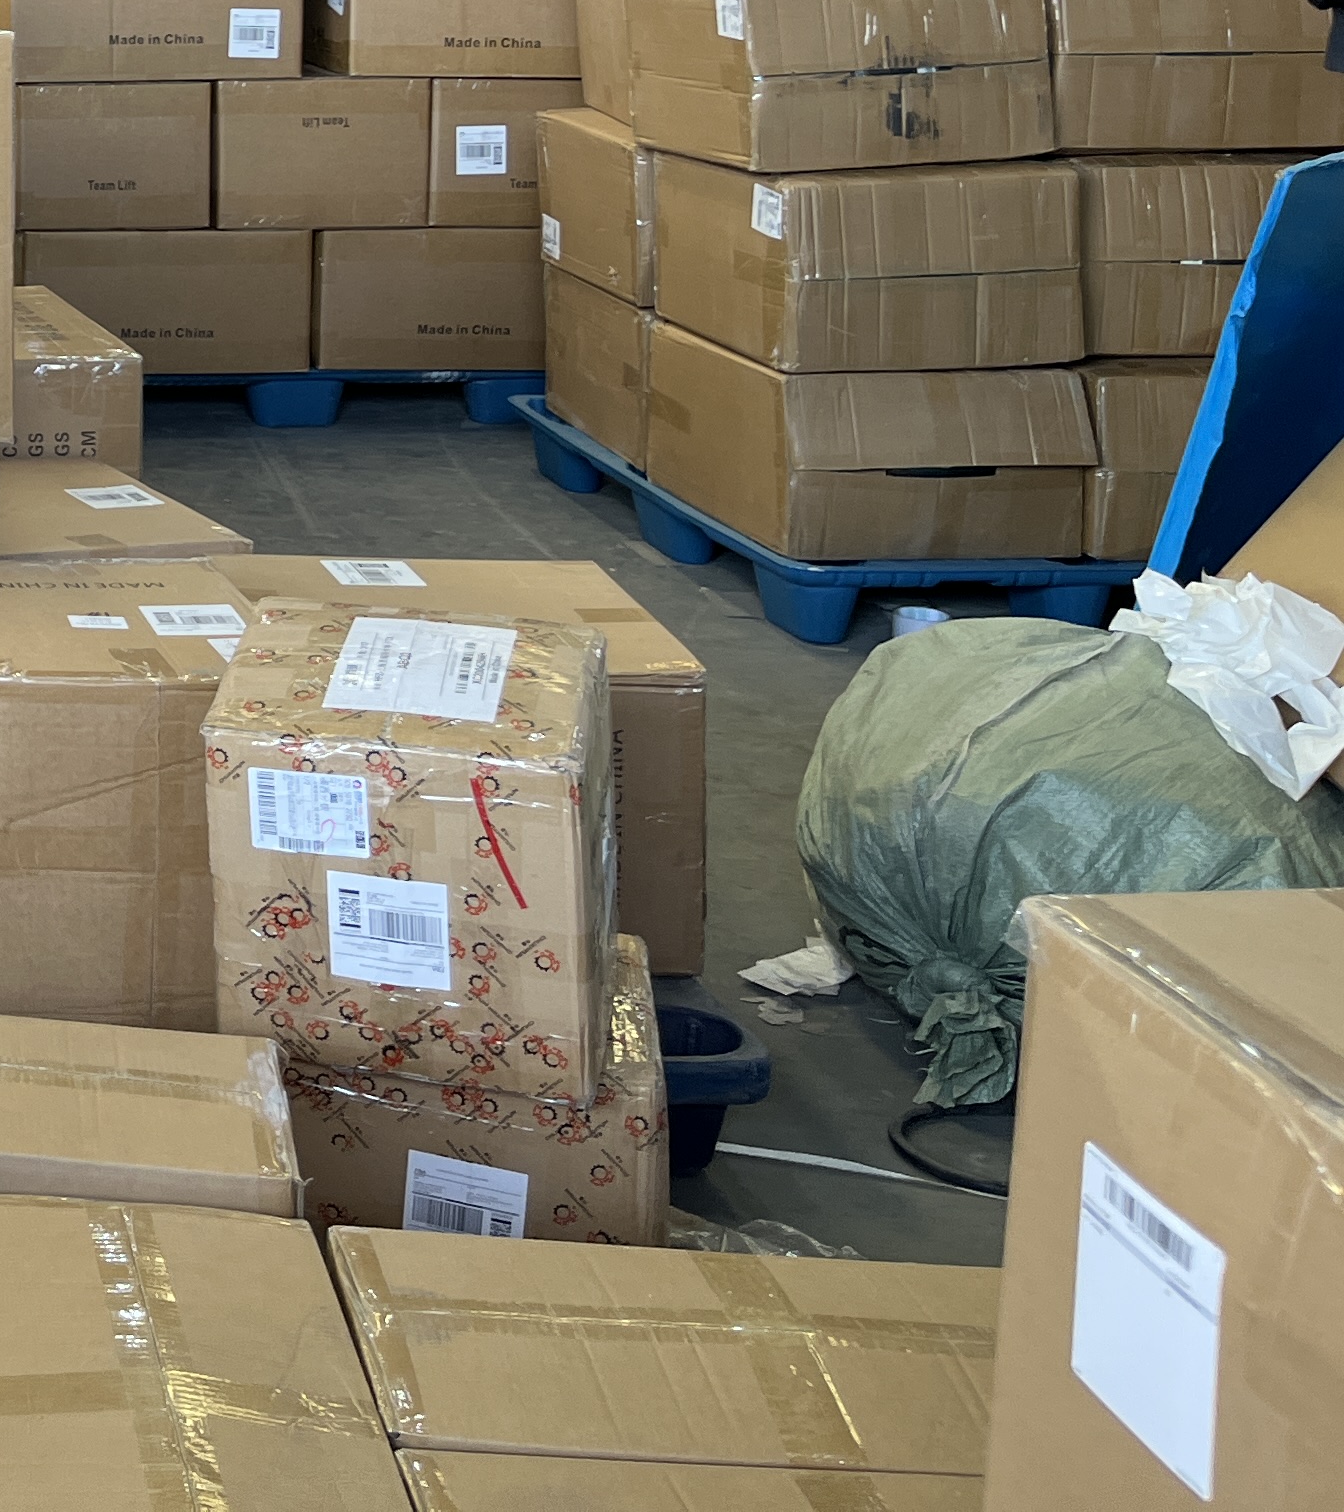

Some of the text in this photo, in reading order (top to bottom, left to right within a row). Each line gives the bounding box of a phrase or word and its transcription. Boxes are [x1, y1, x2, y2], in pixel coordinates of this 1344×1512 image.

[109, 34, 204, 45] Made in China
[443, 37, 542, 49] Made in China
[301, 118, 351, 128] Team Lift
[87, 179, 137, 190] Team Lift
[509, 178, 538, 190] Team
[120, 327, 214, 339] Made in China
[417, 324, 511, 336] Made in China
[81, 431, 97, 458] CM
[64, 581, 90, 590] IN
[96, 581, 165, 590] MADE
